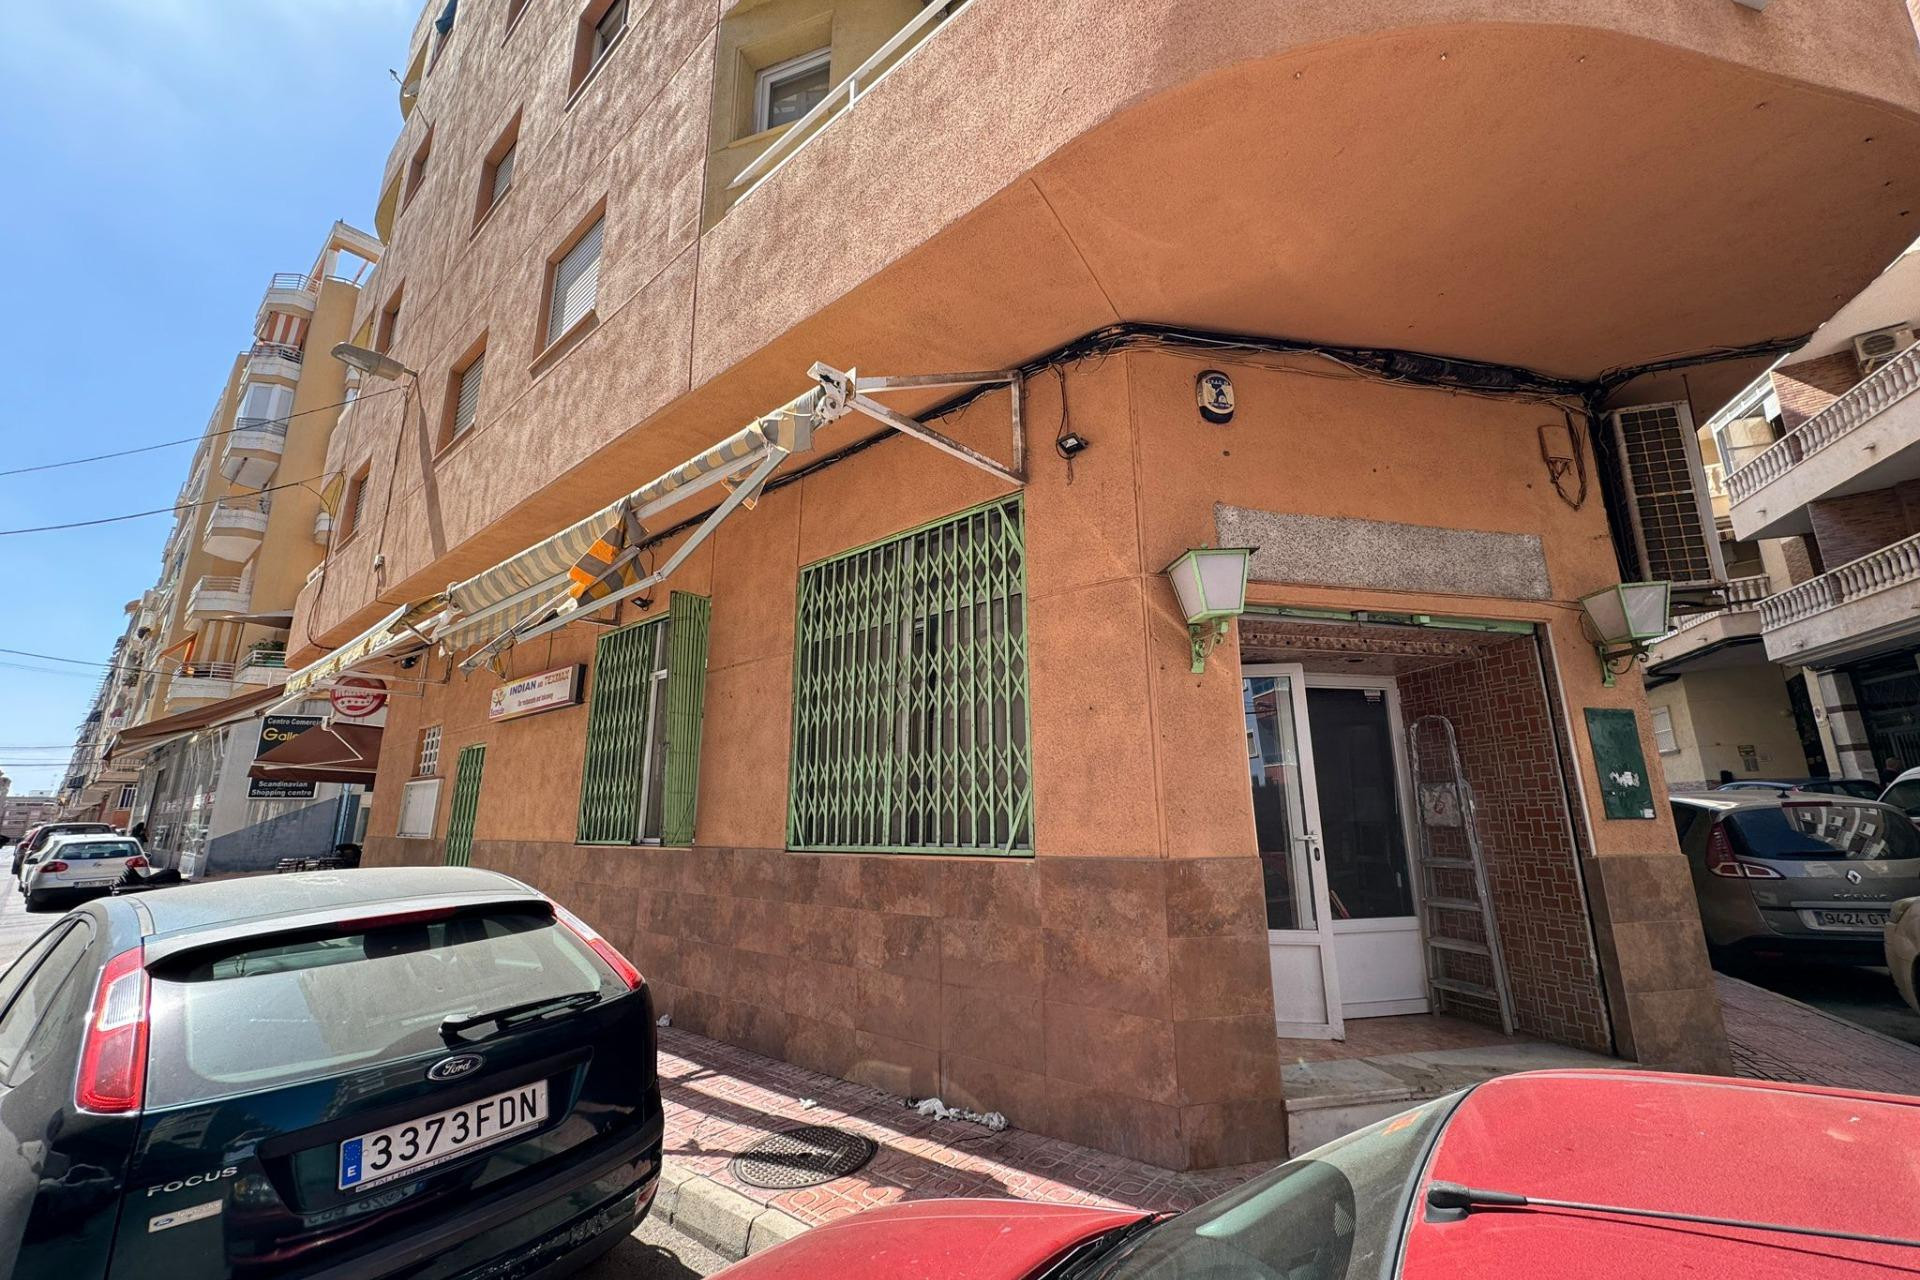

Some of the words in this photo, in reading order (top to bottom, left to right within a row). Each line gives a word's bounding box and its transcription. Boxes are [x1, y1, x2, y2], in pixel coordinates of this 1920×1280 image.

[509, 680, 537, 696] INDIAN
[267, 717, 290, 725] Centro
[258, 780, 308, 788] Scandinavian
[251, 789, 286, 797] Shopping
[1824, 912, 1864, 925] 9424
[1867, 913, 1890, 925] GT
[442, 1059, 471, 1076] Ford
[347, 1165, 357, 1178] E
[147, 1166, 237, 1197] FOCUS
